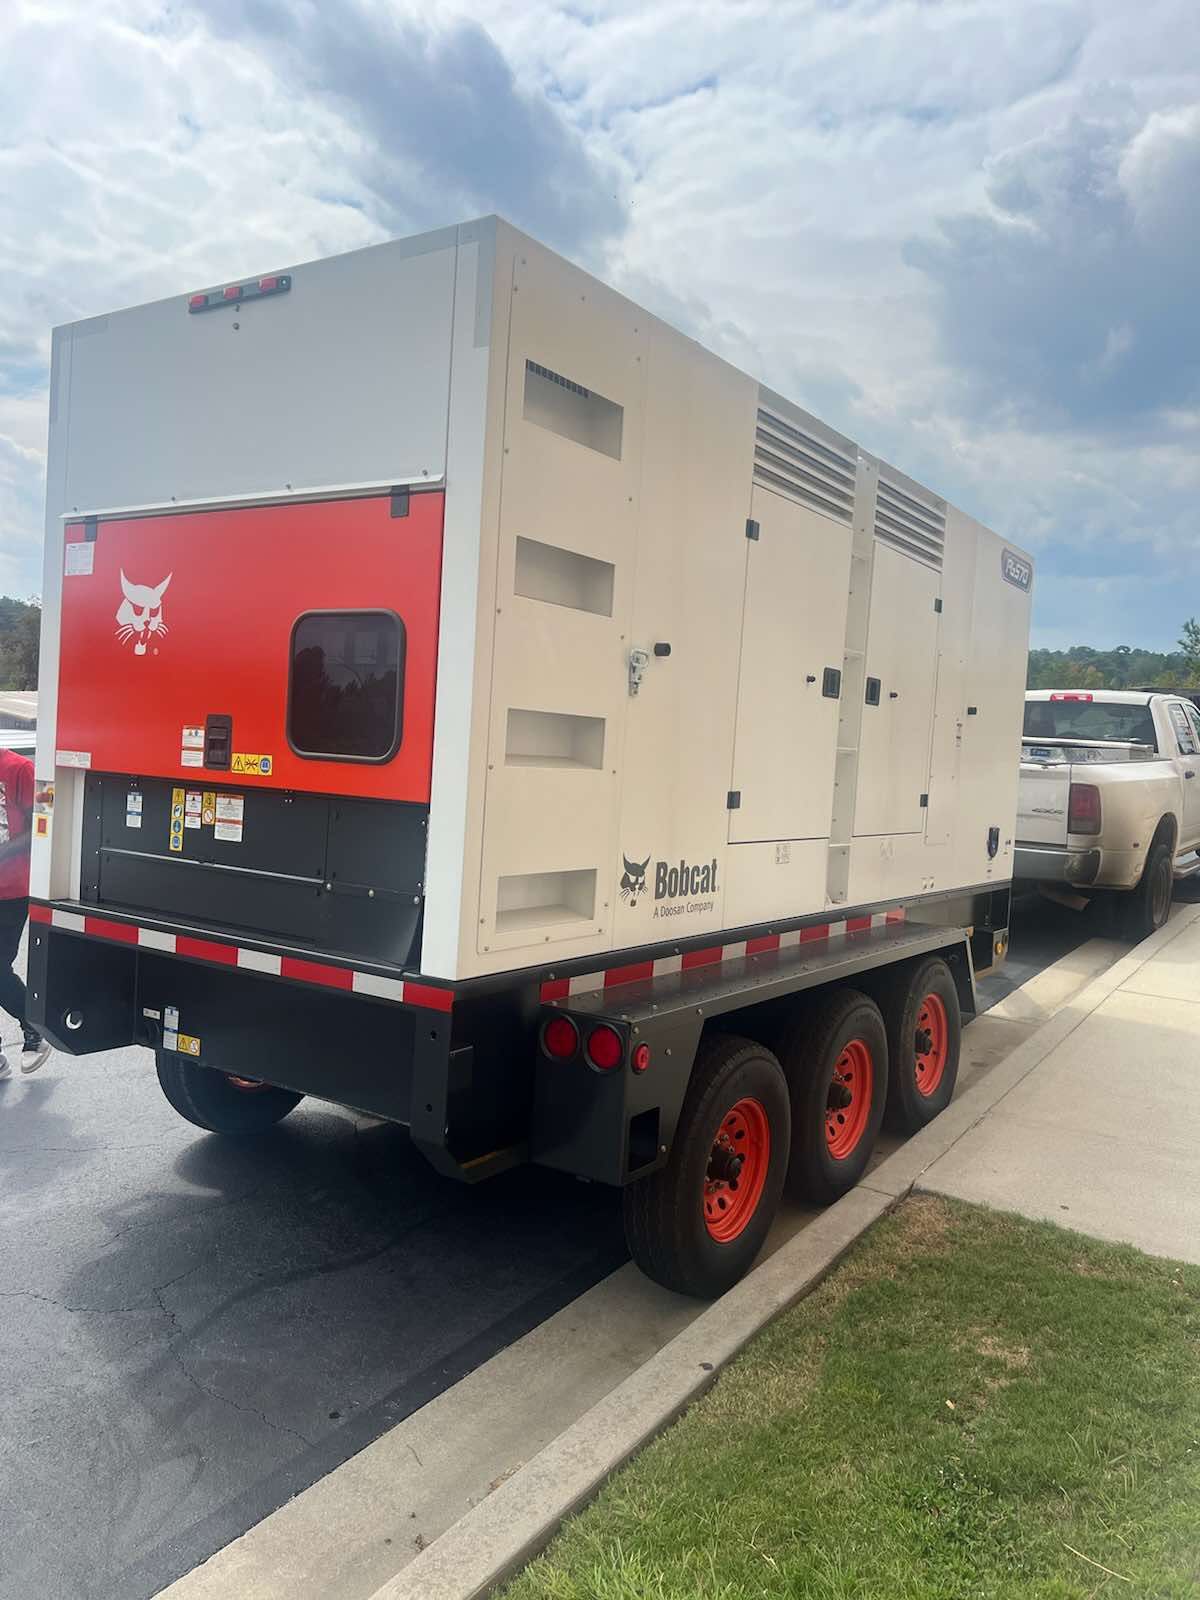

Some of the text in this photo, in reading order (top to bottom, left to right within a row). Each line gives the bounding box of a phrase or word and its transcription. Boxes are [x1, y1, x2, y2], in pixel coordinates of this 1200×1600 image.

[655, 859, 717, 900] Bobcat
[653, 901, 714, 919] A Doosan Company
